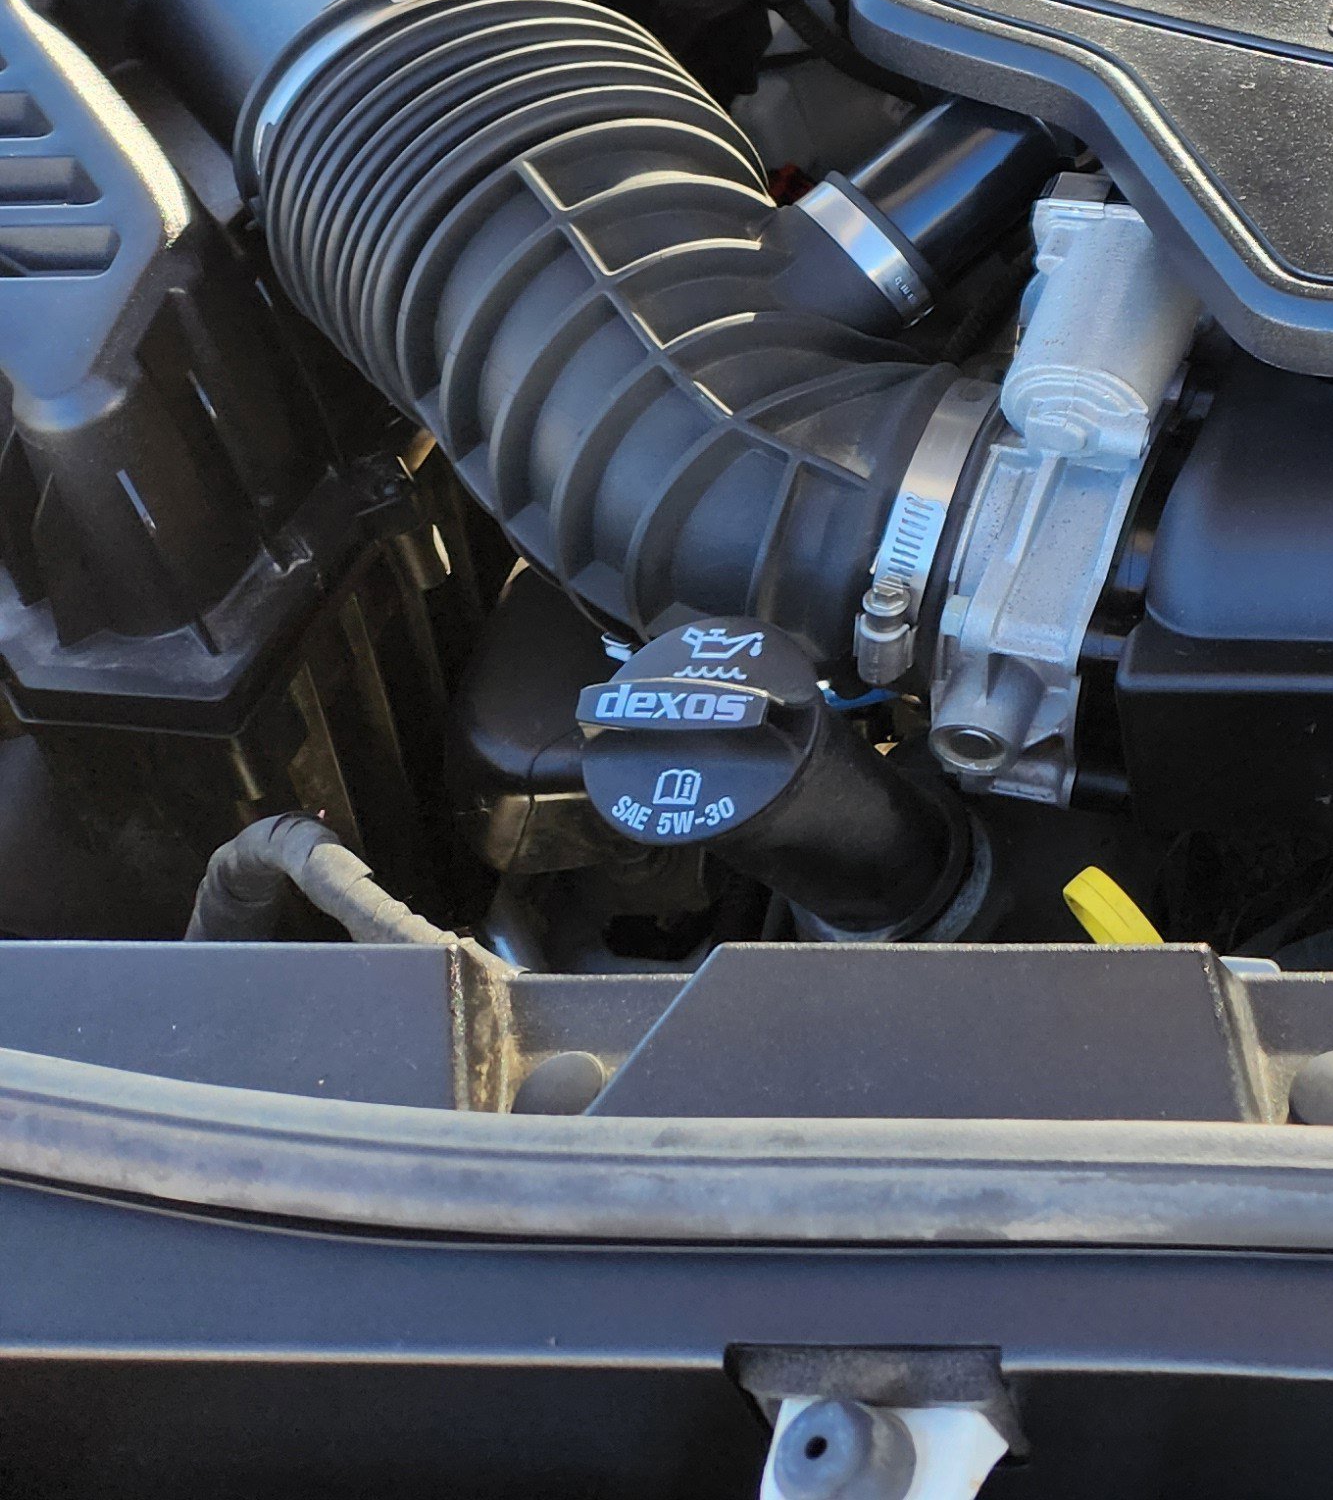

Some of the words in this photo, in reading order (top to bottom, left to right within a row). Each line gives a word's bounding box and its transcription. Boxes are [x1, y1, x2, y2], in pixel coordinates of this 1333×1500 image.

[594, 684, 748, 722] dexos
[611, 795, 653, 831] SAE
[656, 796, 736, 835] 5W-30
